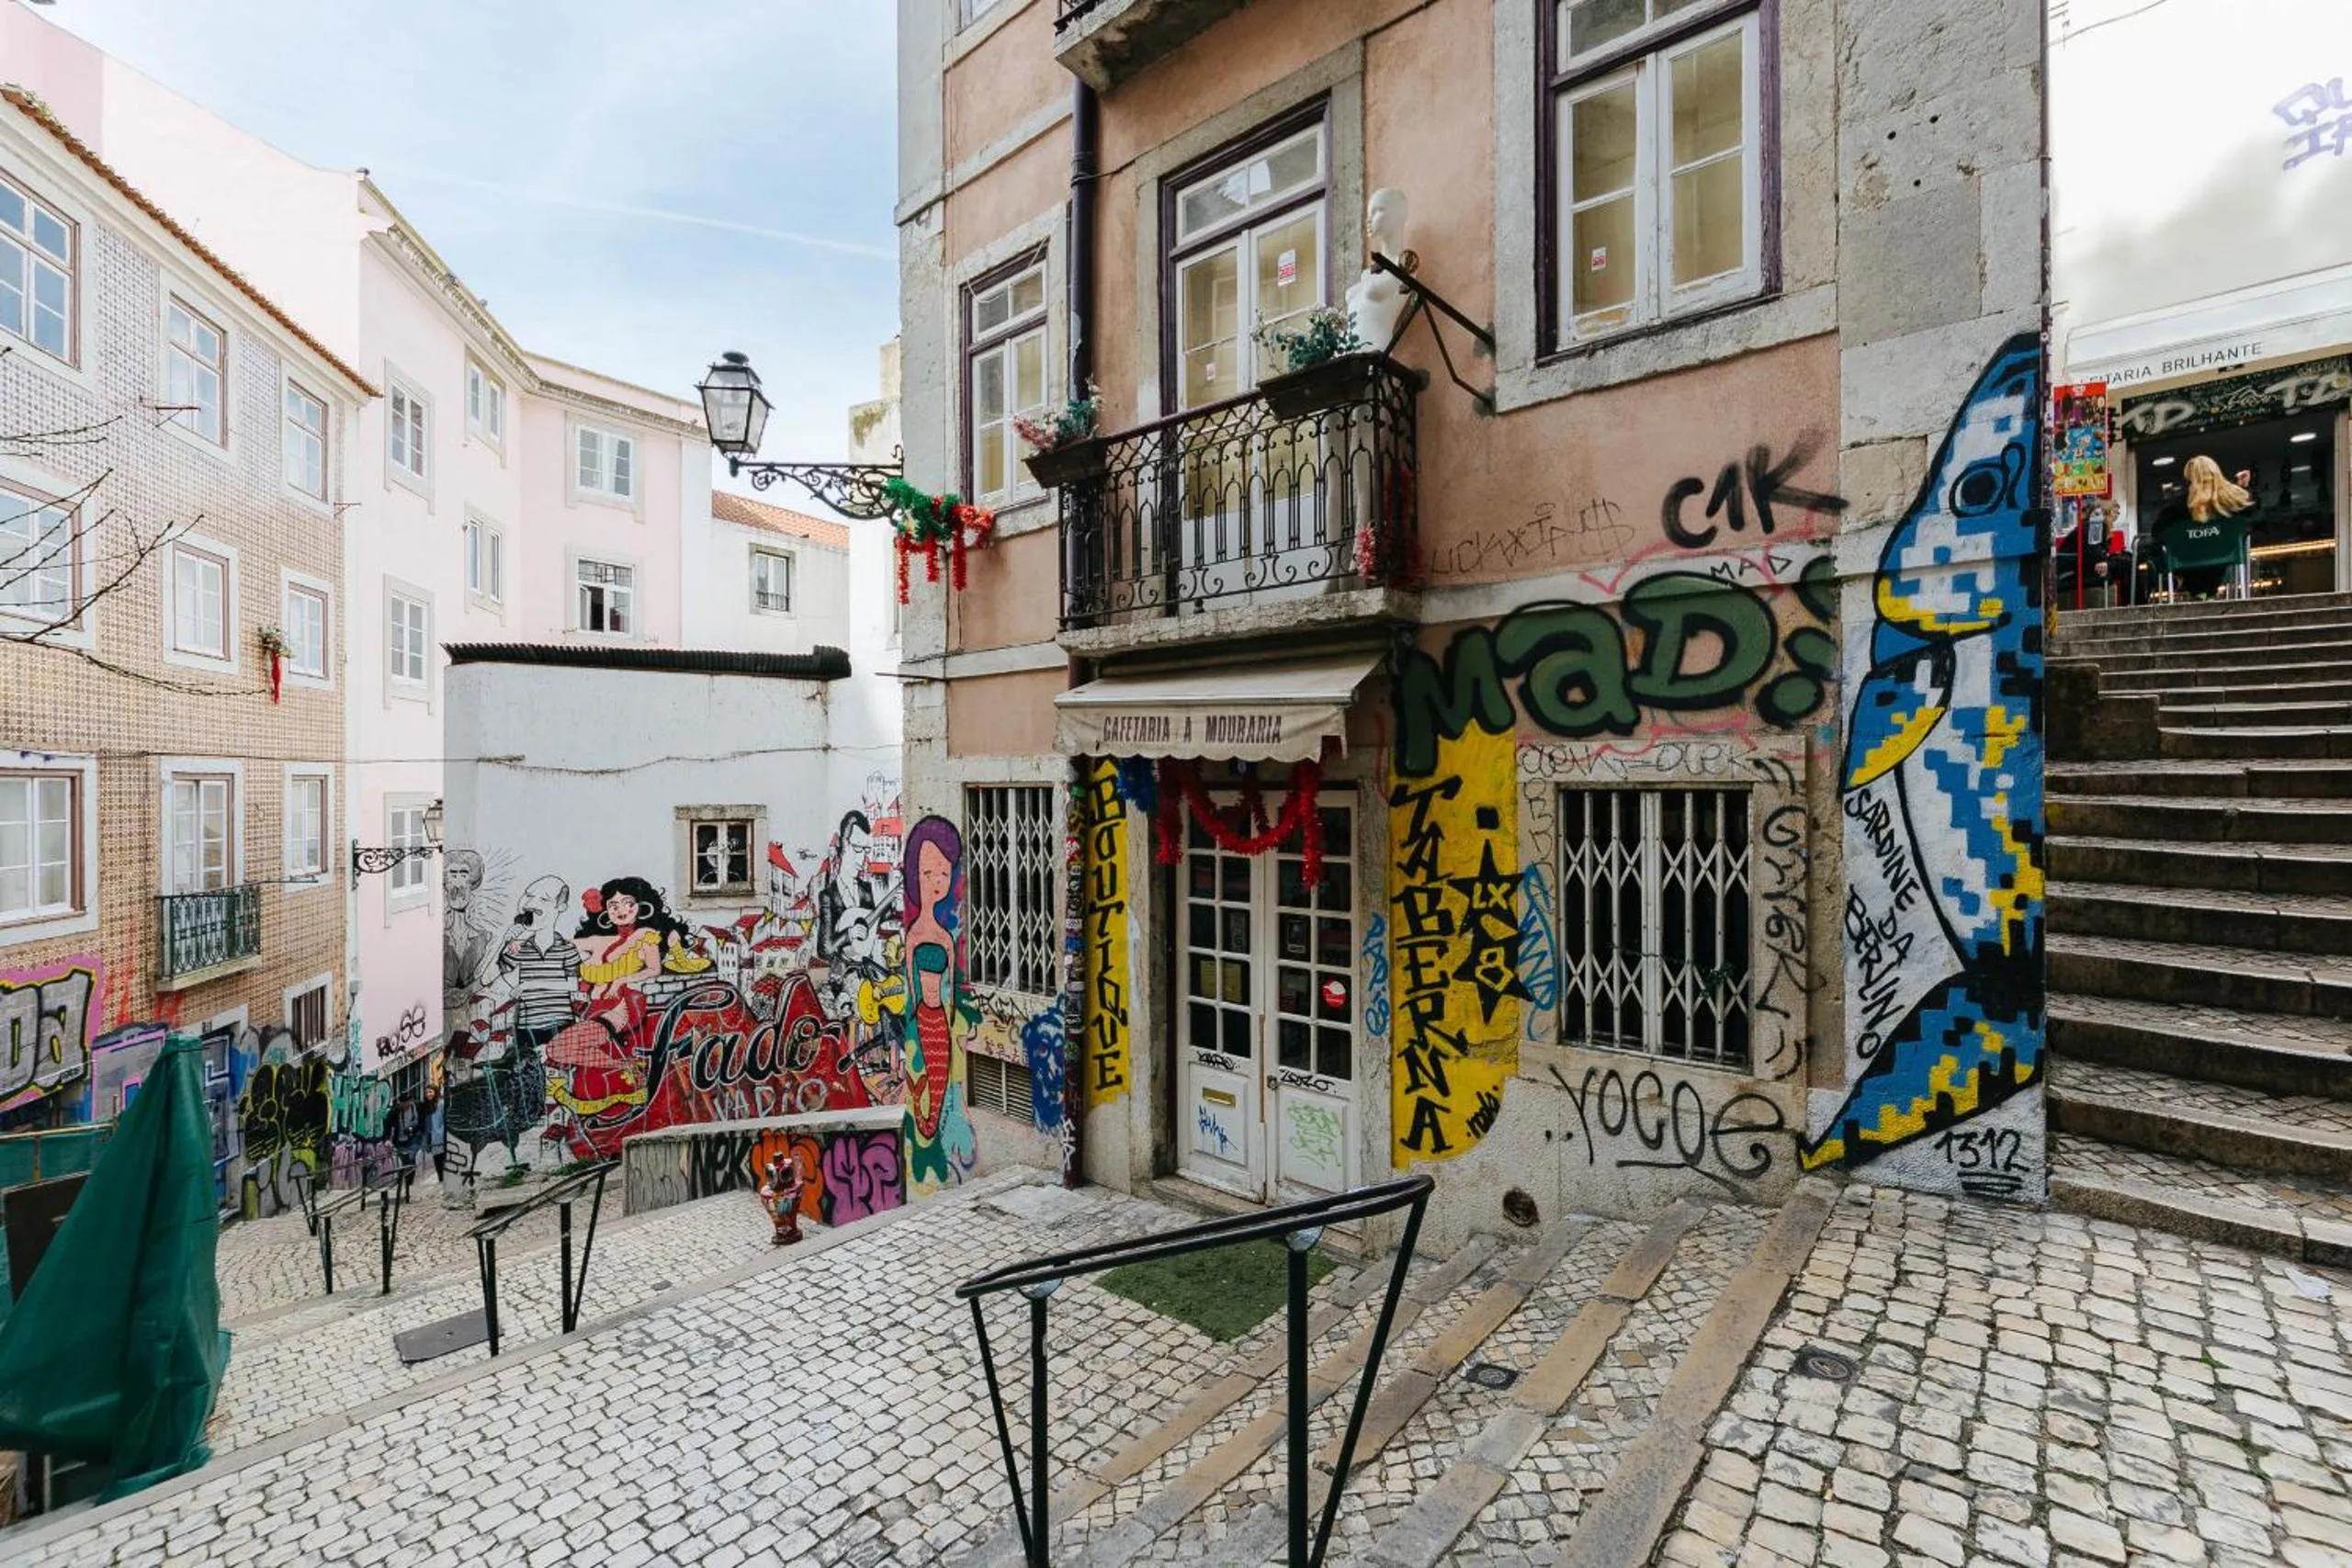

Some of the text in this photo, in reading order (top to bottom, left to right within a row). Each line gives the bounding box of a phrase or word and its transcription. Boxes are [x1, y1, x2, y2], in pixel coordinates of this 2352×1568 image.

[2080, 343, 2263, 385] TARIA BRILHANTE
[2187, 526, 2220, 538] TOFA
[1182, 716, 1193, 743] A
[1204, 716, 1283, 743] MOURARIA
[1844, 788, 1920, 911] SARDINE
[1472, 882, 1511, 909] LX
[1878, 907, 1914, 967] DA
[1390, 774, 1469, 1154] TABERNA
[1934, 1127, 2030, 1172] 1312
